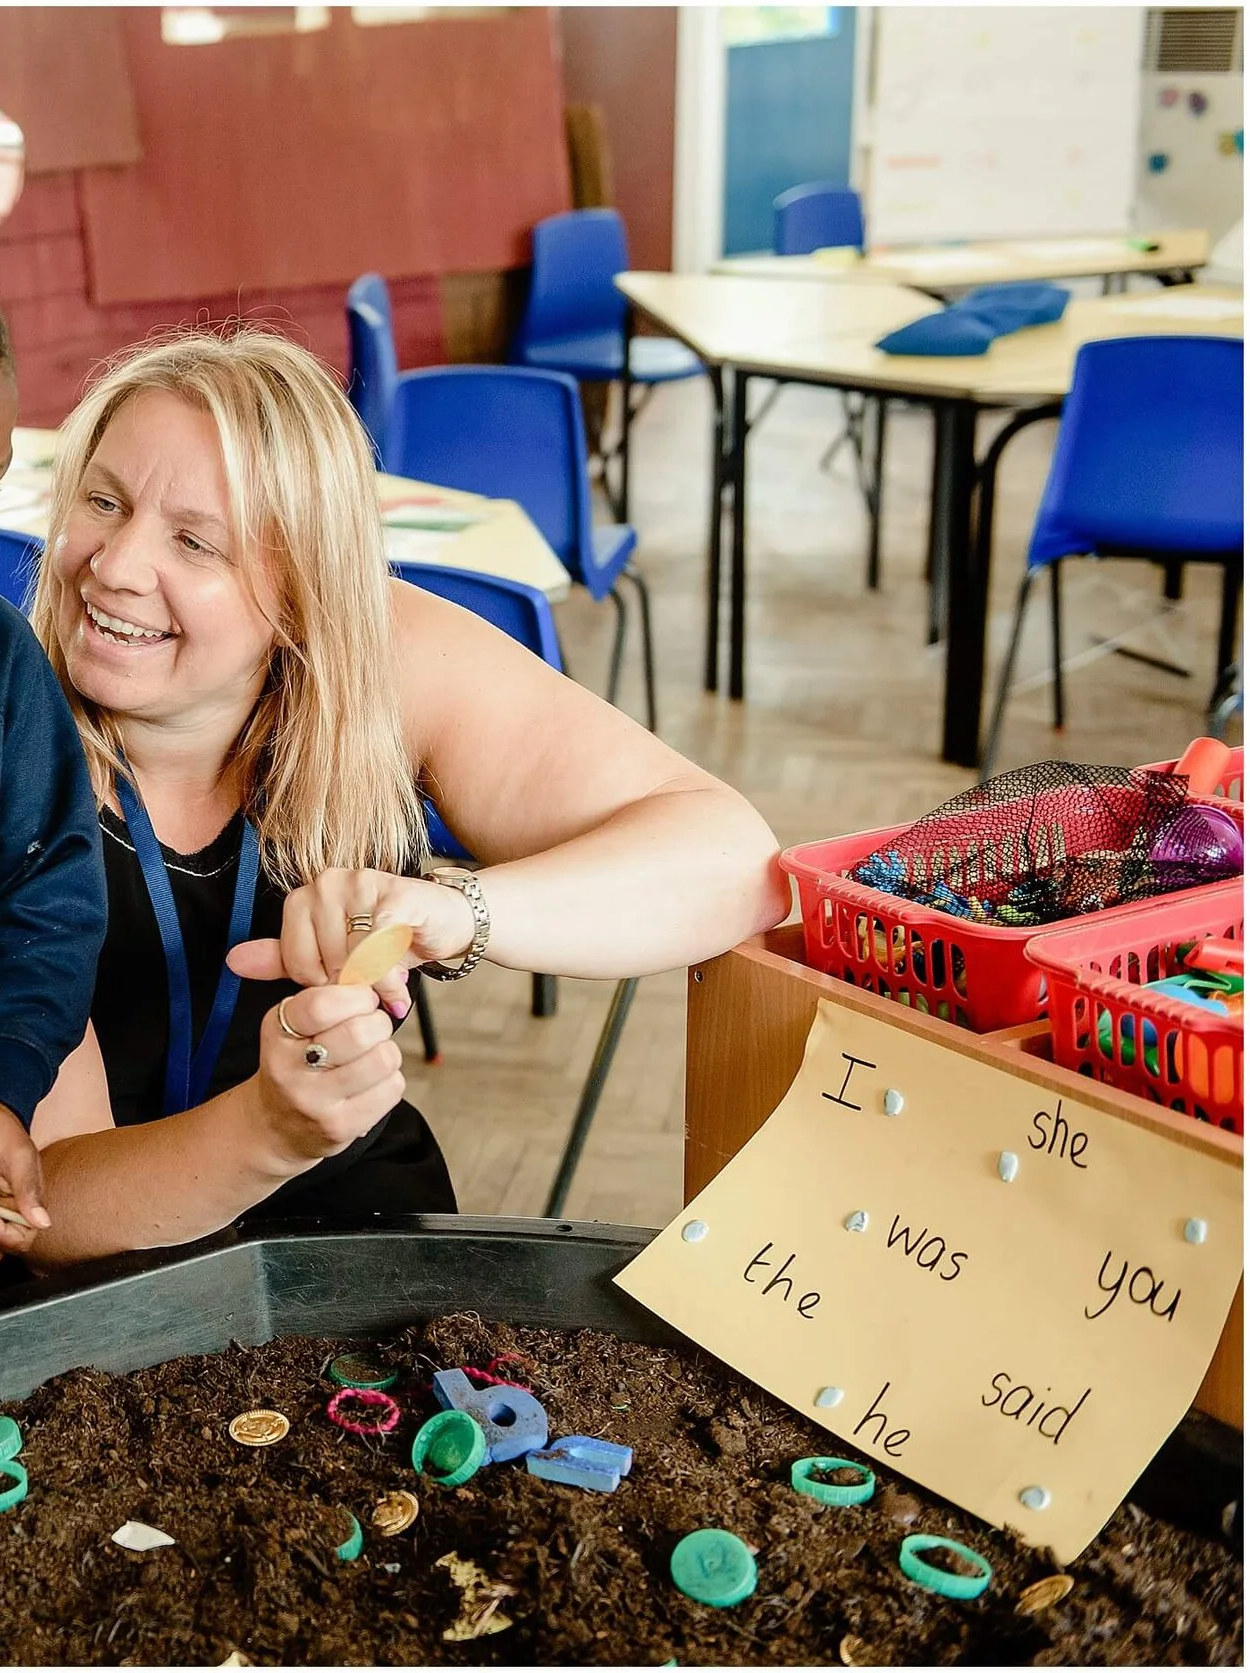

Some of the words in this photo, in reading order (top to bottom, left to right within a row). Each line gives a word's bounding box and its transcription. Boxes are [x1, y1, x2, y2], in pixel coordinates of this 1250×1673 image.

[822, 1053, 877, 1111] I
[1027, 1100, 1089, 1169] she
[743, 1243, 821, 1319] the
[887, 1215, 969, 1281] was
[1084, 1251, 1182, 1322] you
[853, 1382, 911, 1457] he
[981, 1373, 1092, 1445] said
